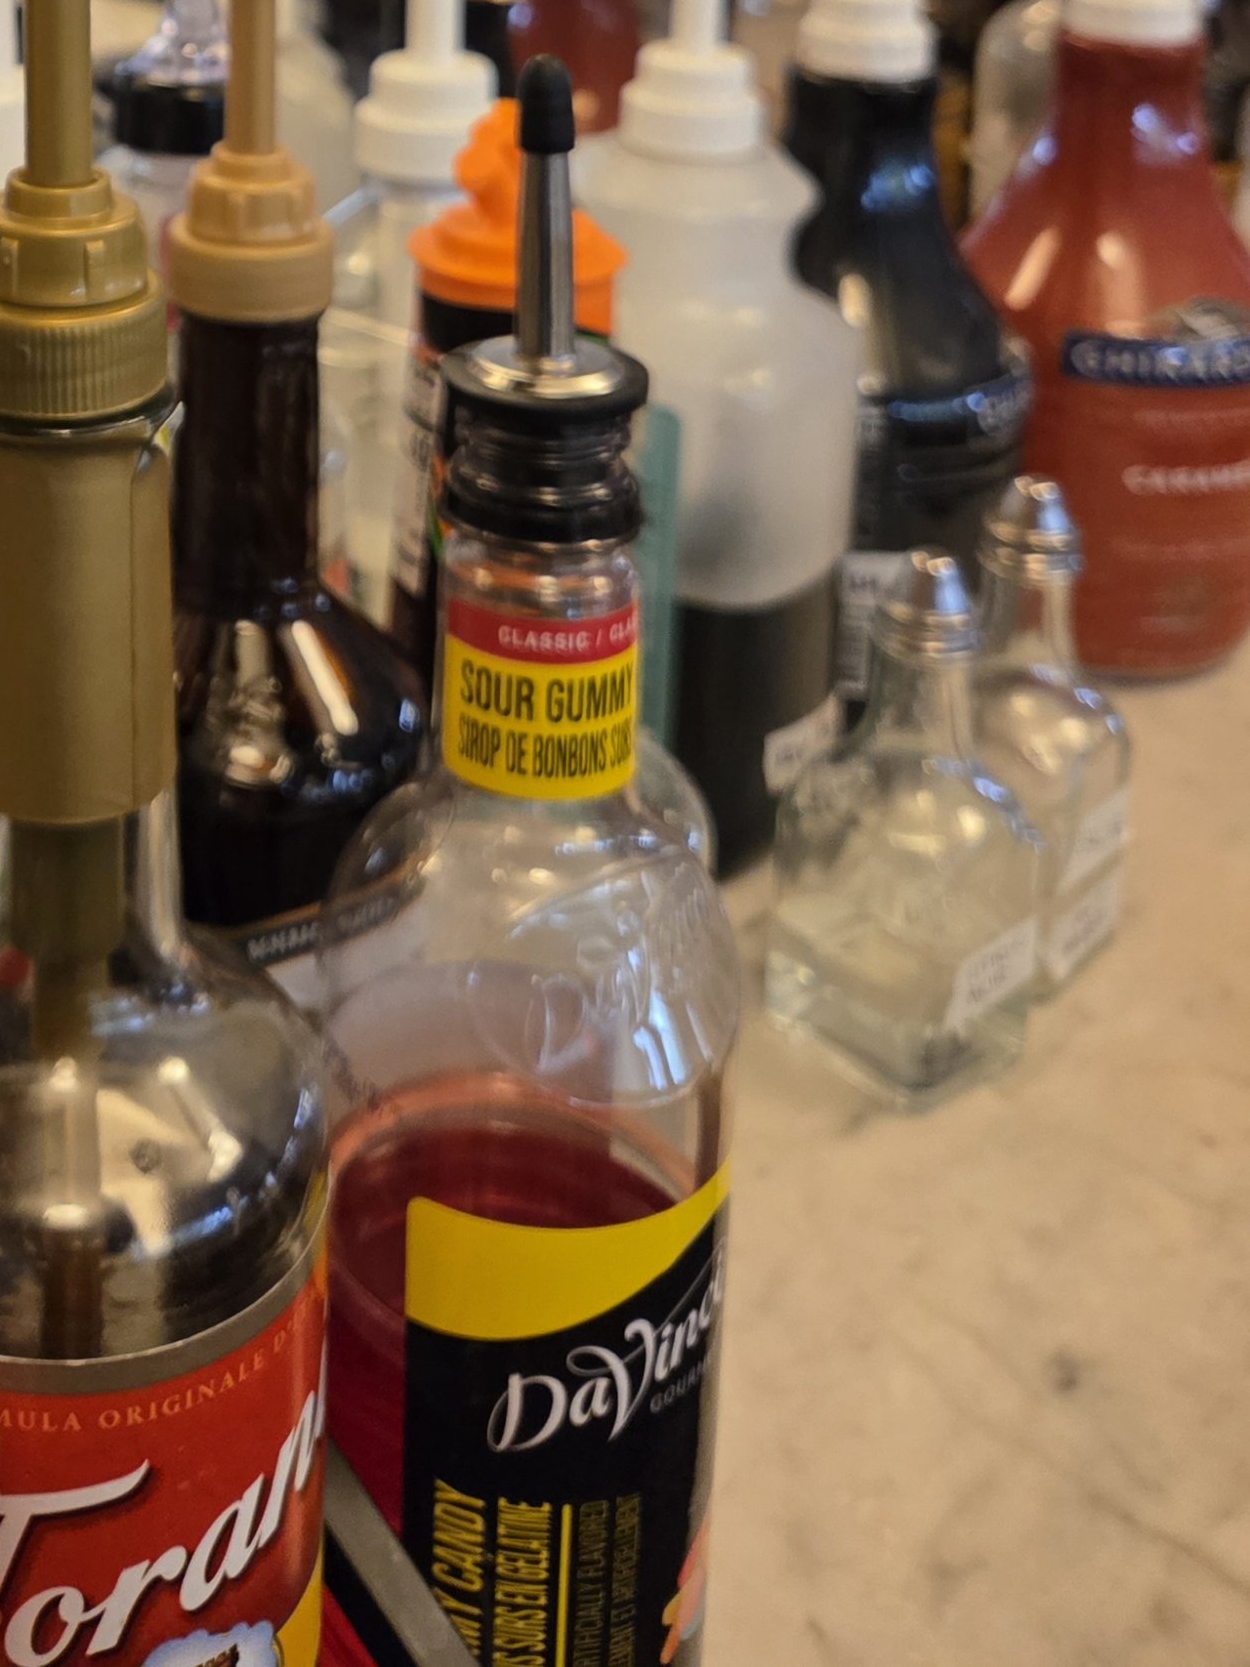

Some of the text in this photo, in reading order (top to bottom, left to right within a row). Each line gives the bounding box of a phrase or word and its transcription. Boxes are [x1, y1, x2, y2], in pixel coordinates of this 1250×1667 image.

[498, 624, 589, 651] CLASSIC
[460, 660, 633, 724] SOUR GUMMY
[459, 712, 500, 770] SIROP
[504, 729, 528, 776] DE
[532, 726, 608, 780] BONBONS
[98, 1345, 266, 1430] ORIGINALE
[432, 1478, 486, 1593] CANDY
[496, 1496, 553, 1580] GELATINE
[495, 1580, 549, 1607] EN
